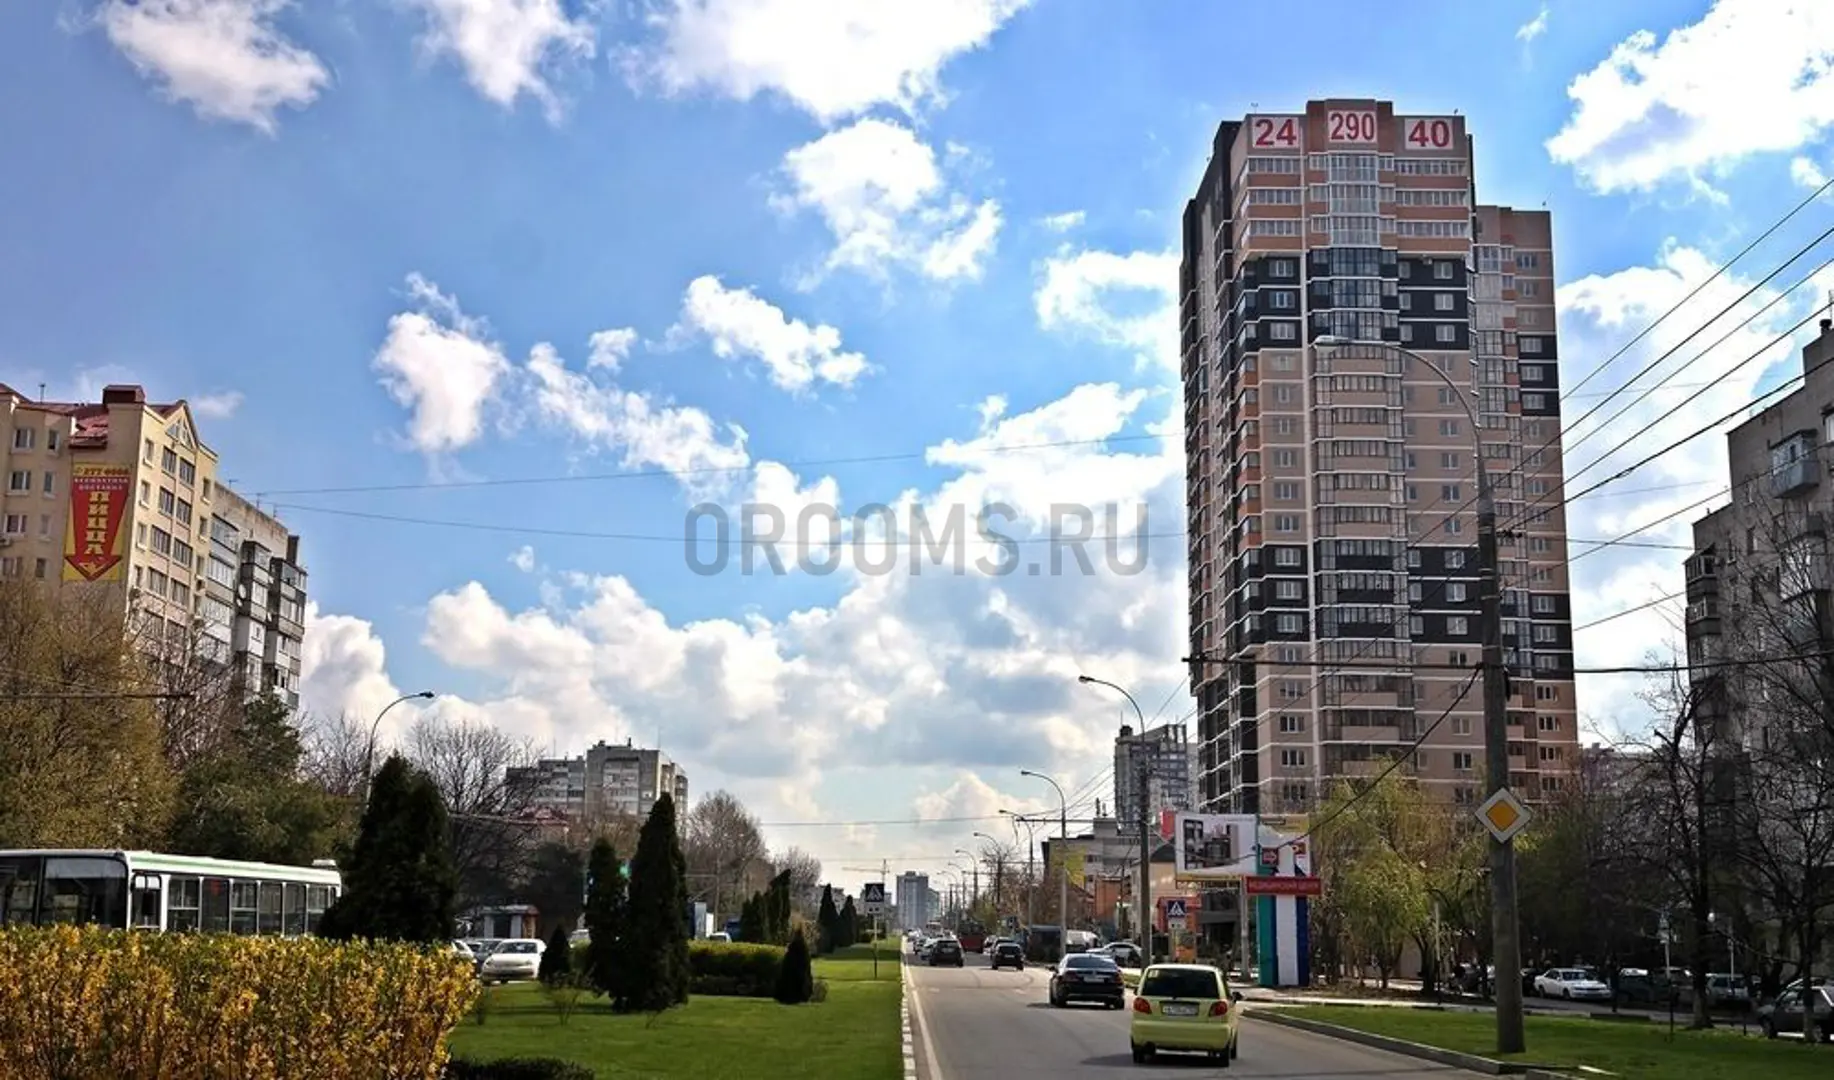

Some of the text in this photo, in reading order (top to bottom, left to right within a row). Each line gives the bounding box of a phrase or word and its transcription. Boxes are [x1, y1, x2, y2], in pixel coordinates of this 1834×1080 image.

[1255, 112, 1450, 148] 24 290 40
